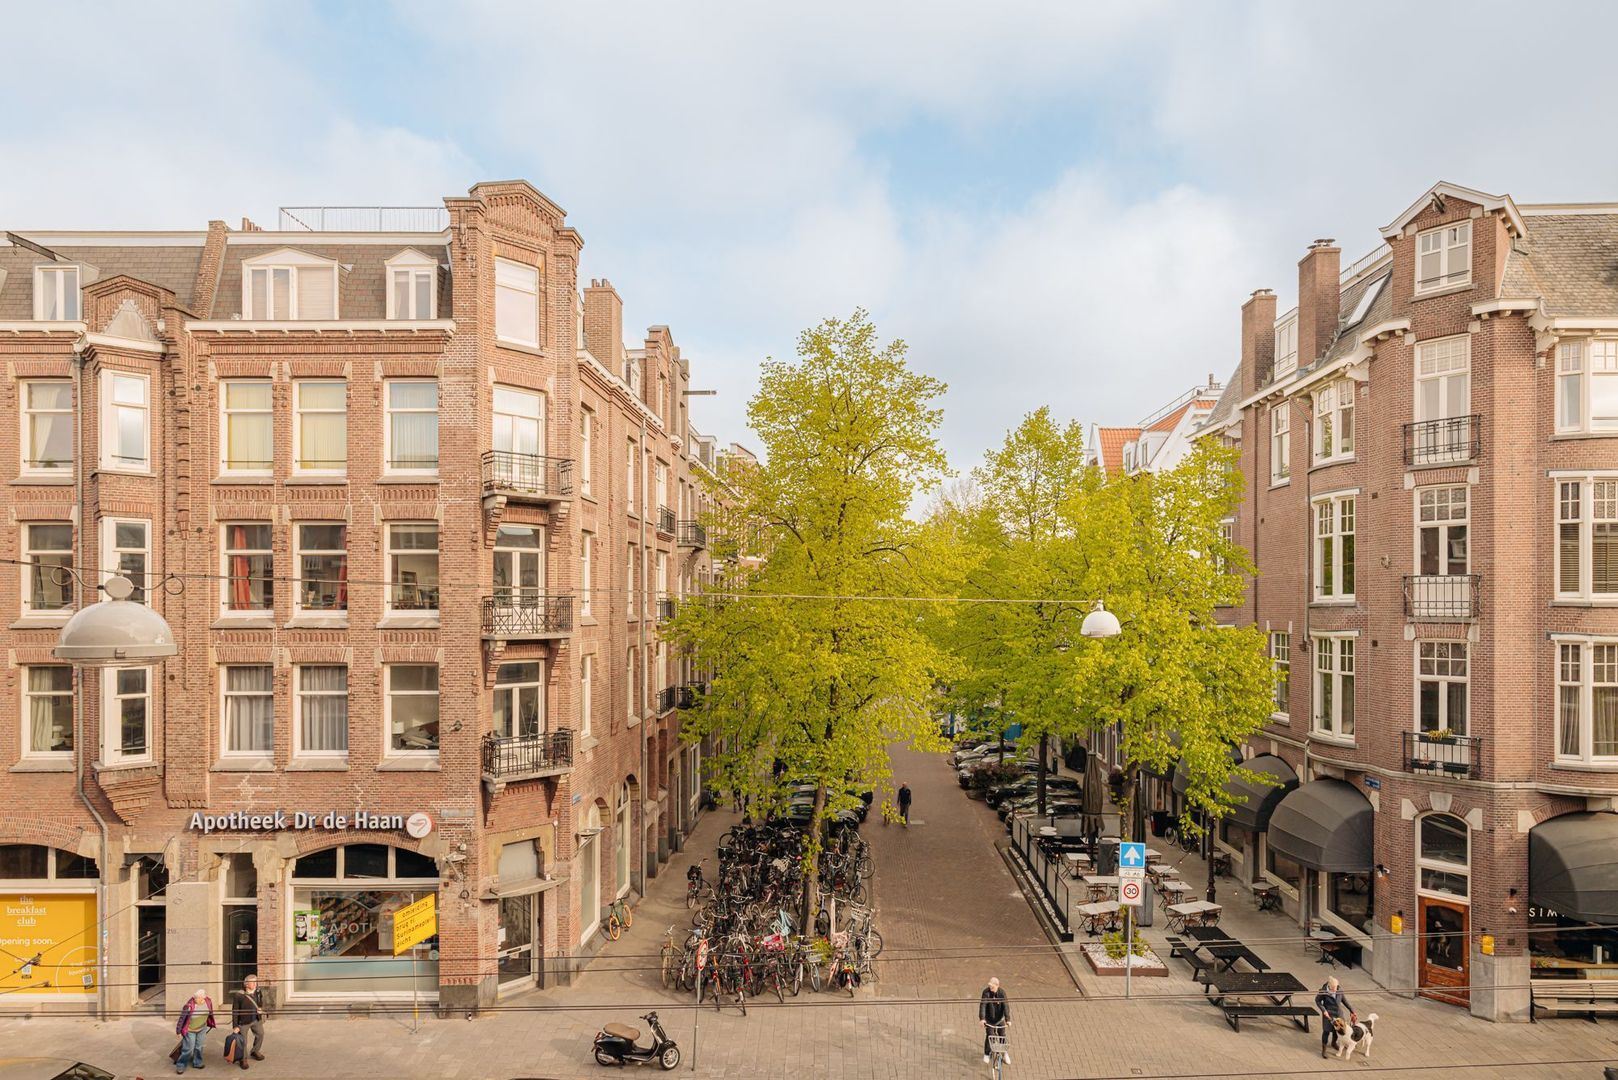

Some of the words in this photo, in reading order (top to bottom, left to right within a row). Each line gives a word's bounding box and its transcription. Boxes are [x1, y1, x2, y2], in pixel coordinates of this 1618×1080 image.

[189, 811, 287, 834] Apotheek
[294, 811, 316, 829] Dr
[323, 811, 347, 829] de
[354, 811, 404, 829] Haan
[1126, 887, 1137, 895] 30
[20, 896, 33, 904] the
[7, 905, 47, 915] breakfast
[1529, 907, 1565, 918] SIM
[17, 916, 36, 925] club
[329, 922, 380, 934] APOTH
[0, 938, 31, 947] pening
